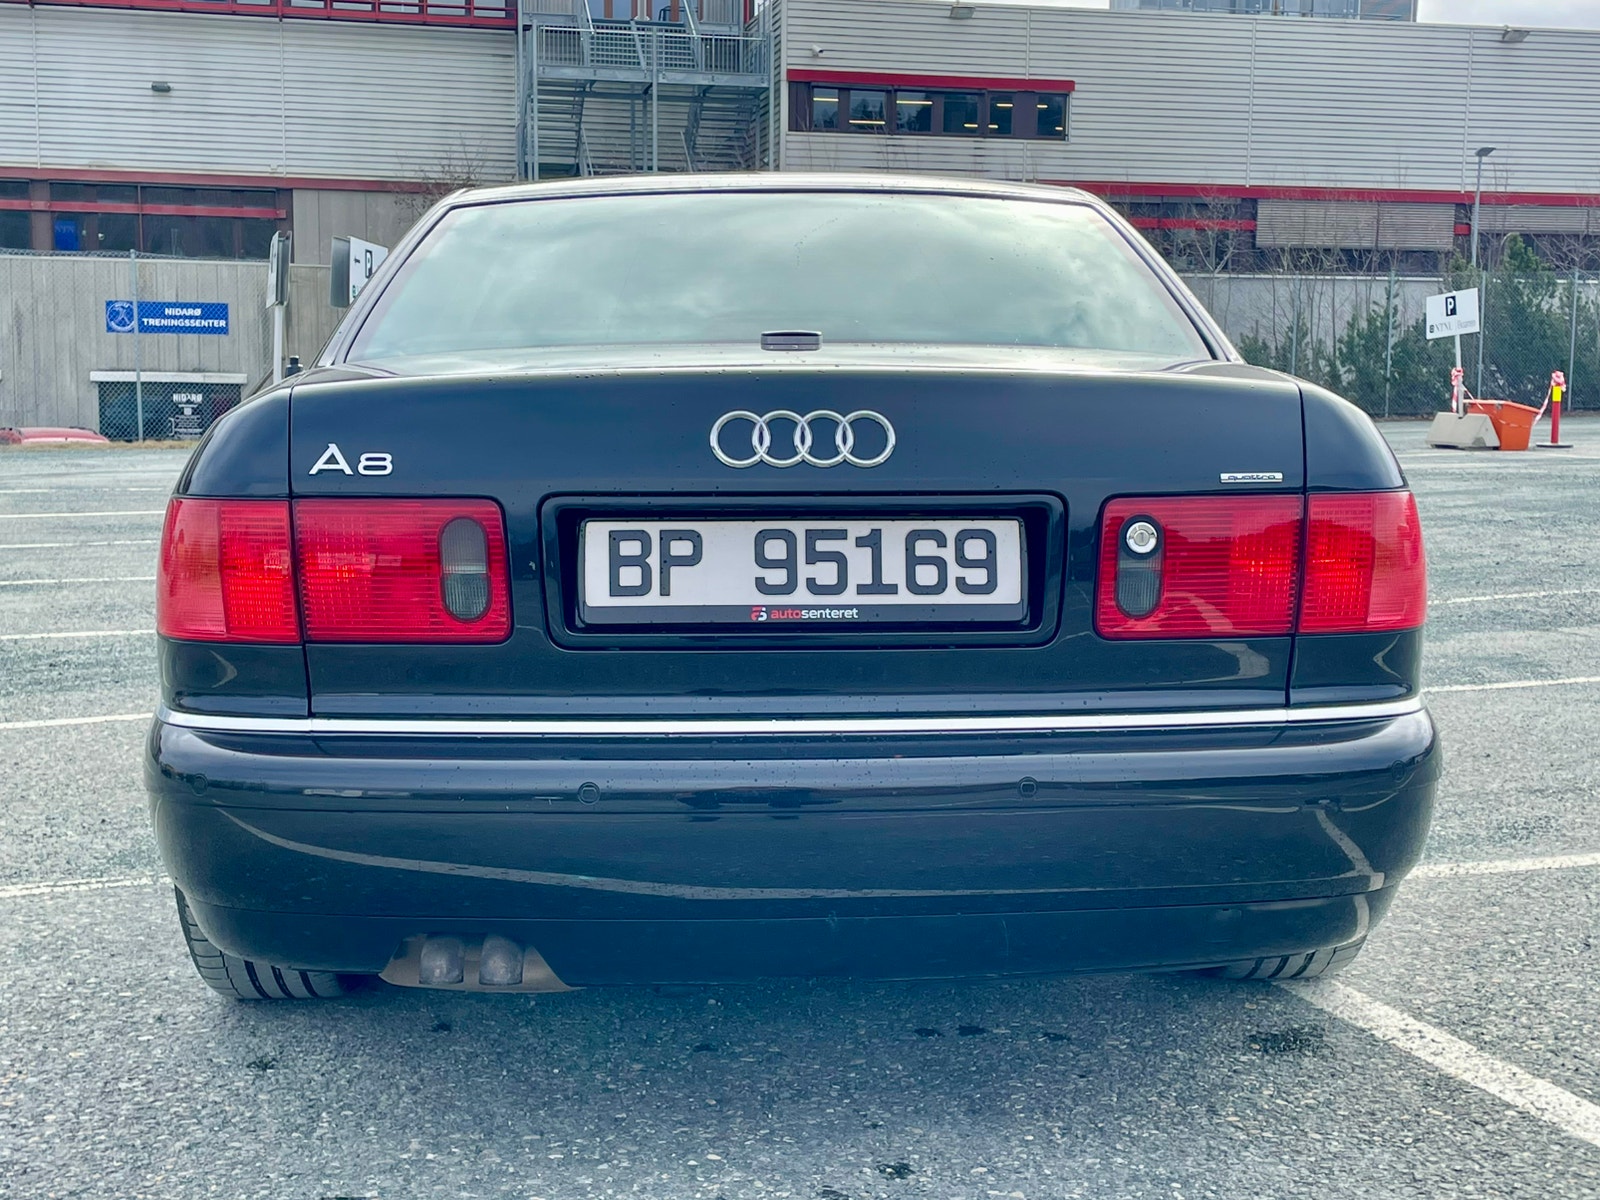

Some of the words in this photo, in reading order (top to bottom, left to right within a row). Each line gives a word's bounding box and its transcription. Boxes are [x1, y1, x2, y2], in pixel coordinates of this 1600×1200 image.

[164, 307, 202, 316] NIDARØ
[1447, 298, 1454, 315] P
[142, 318, 226, 328] TRENINGSSENTER
[308, 443, 393, 476] A8
[608, 529, 703, 597] BP
[754, 528, 998, 596] 95169
[770, 607, 859, 620] autosenteret
